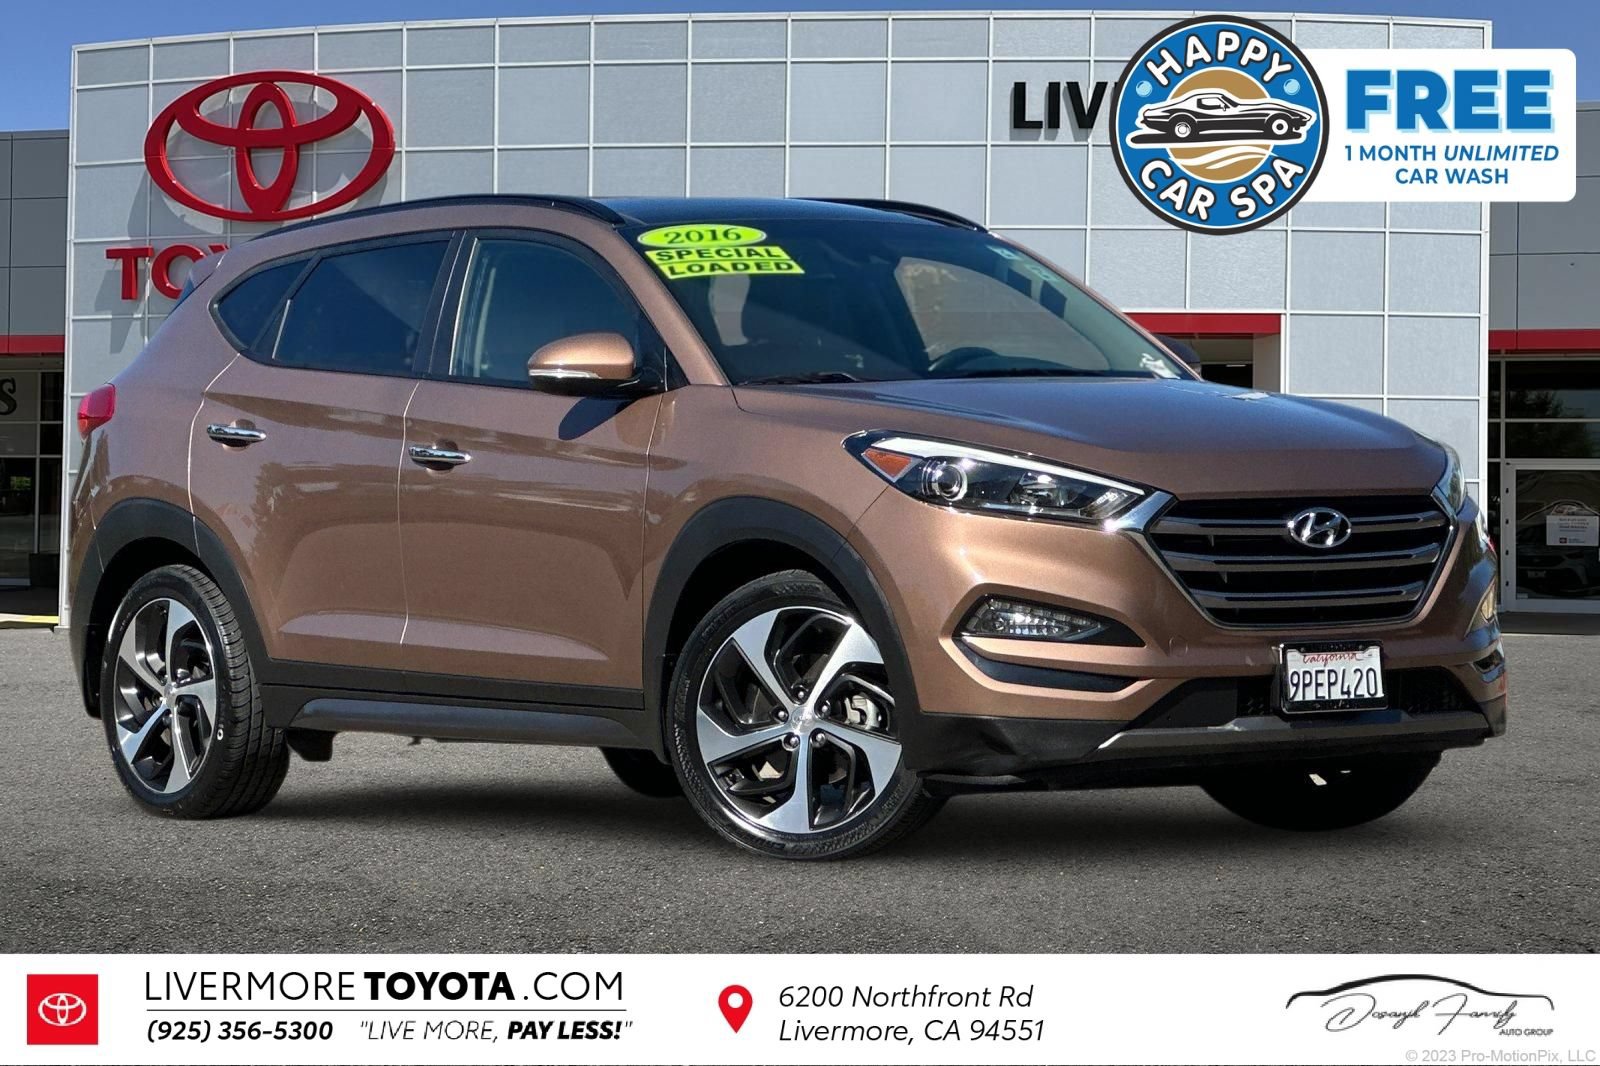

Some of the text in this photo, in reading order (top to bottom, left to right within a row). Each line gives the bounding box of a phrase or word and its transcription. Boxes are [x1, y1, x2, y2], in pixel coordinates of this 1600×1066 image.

[1013, 81, 1120, 129] LIV
[663, 227, 742, 244] 2016
[656, 247, 782, 261] SPECIAL
[105, 243, 229, 300] TO
[668, 262, 793, 276] LOADED
[1290, 667, 1378, 701] 9PEP420
